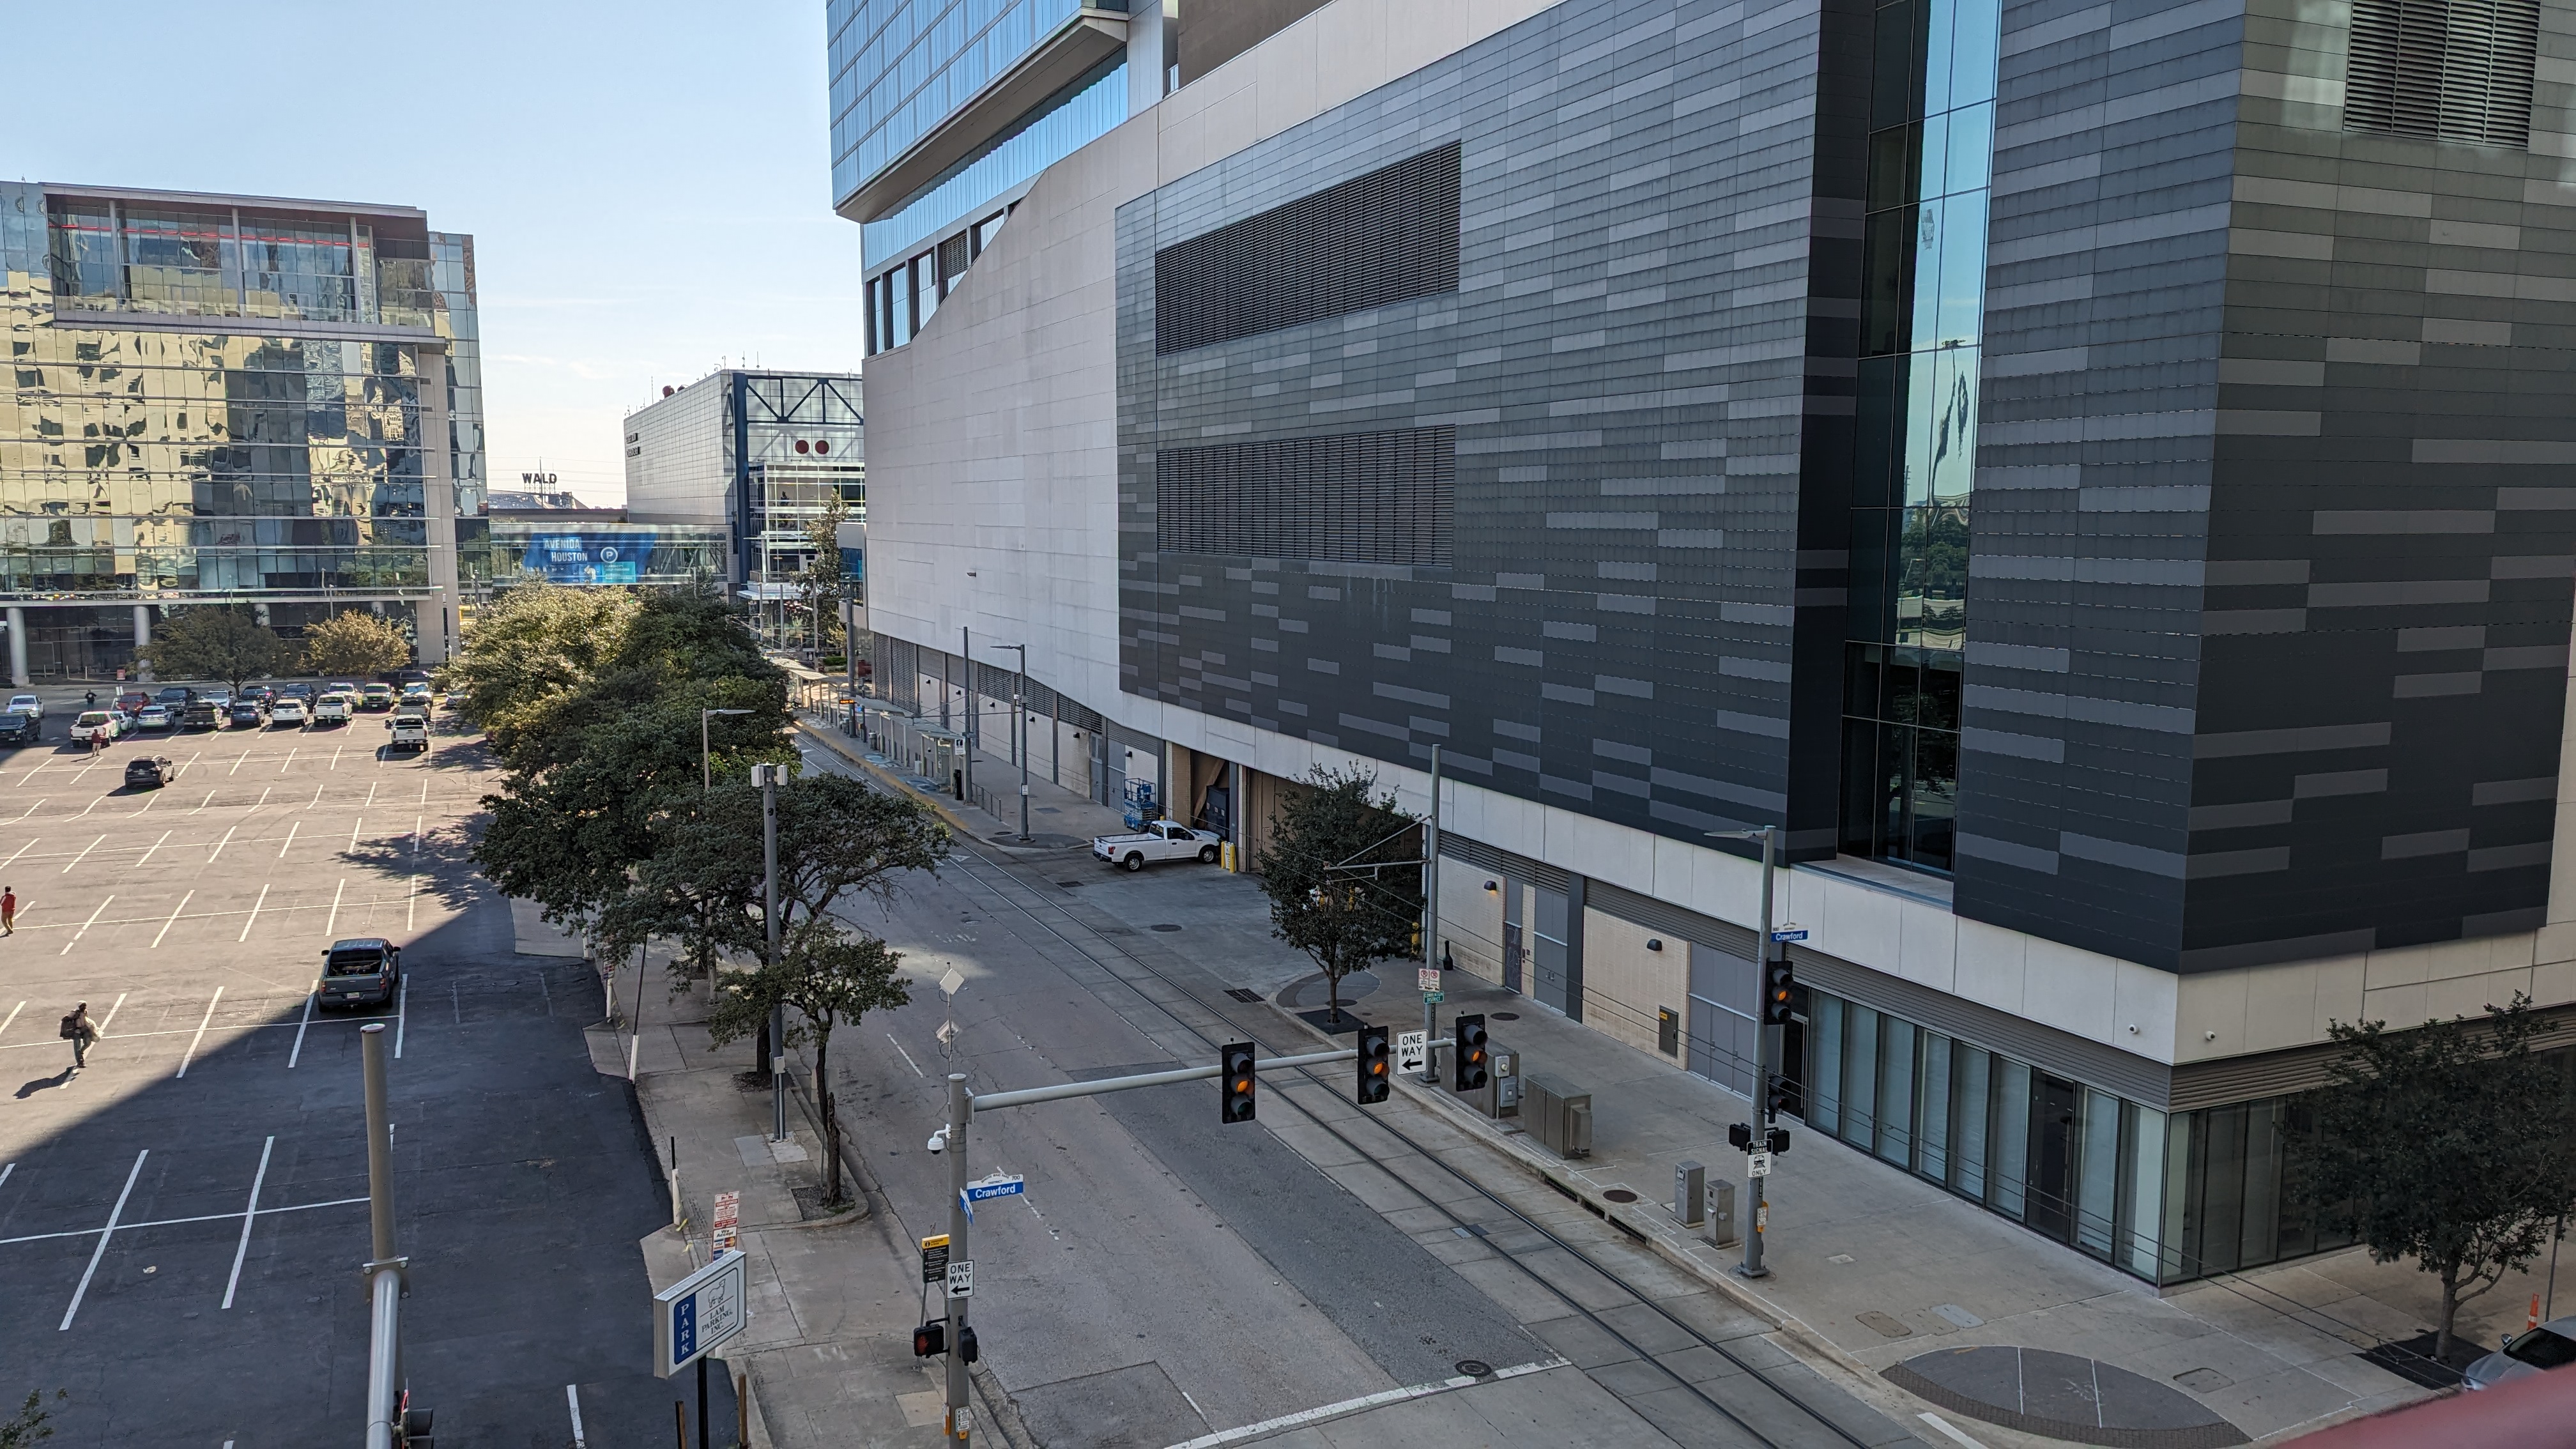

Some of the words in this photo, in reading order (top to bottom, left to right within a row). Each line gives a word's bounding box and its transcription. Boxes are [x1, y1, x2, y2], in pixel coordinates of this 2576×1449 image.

[522, 473, 557, 484] WALD
[544, 539, 580, 549] AVENIDA
[551, 552, 588, 562] HOUSTON
[606, 551, 613, 559] P
[1775, 931, 1803, 941] Crawford
[1402, 1034, 1423, 1046] ONE
[1401, 1045, 1423, 1057] WAY
[1751, 1147, 1768, 1155] SIGNAL
[975, 1184, 1016, 1199] Crawford
[950, 1262, 970, 1274] ONE
[949, 1273, 971, 1284] WAY
[710, 1305, 724, 1320] LAM
[680, 1303, 690, 1356] PARK
